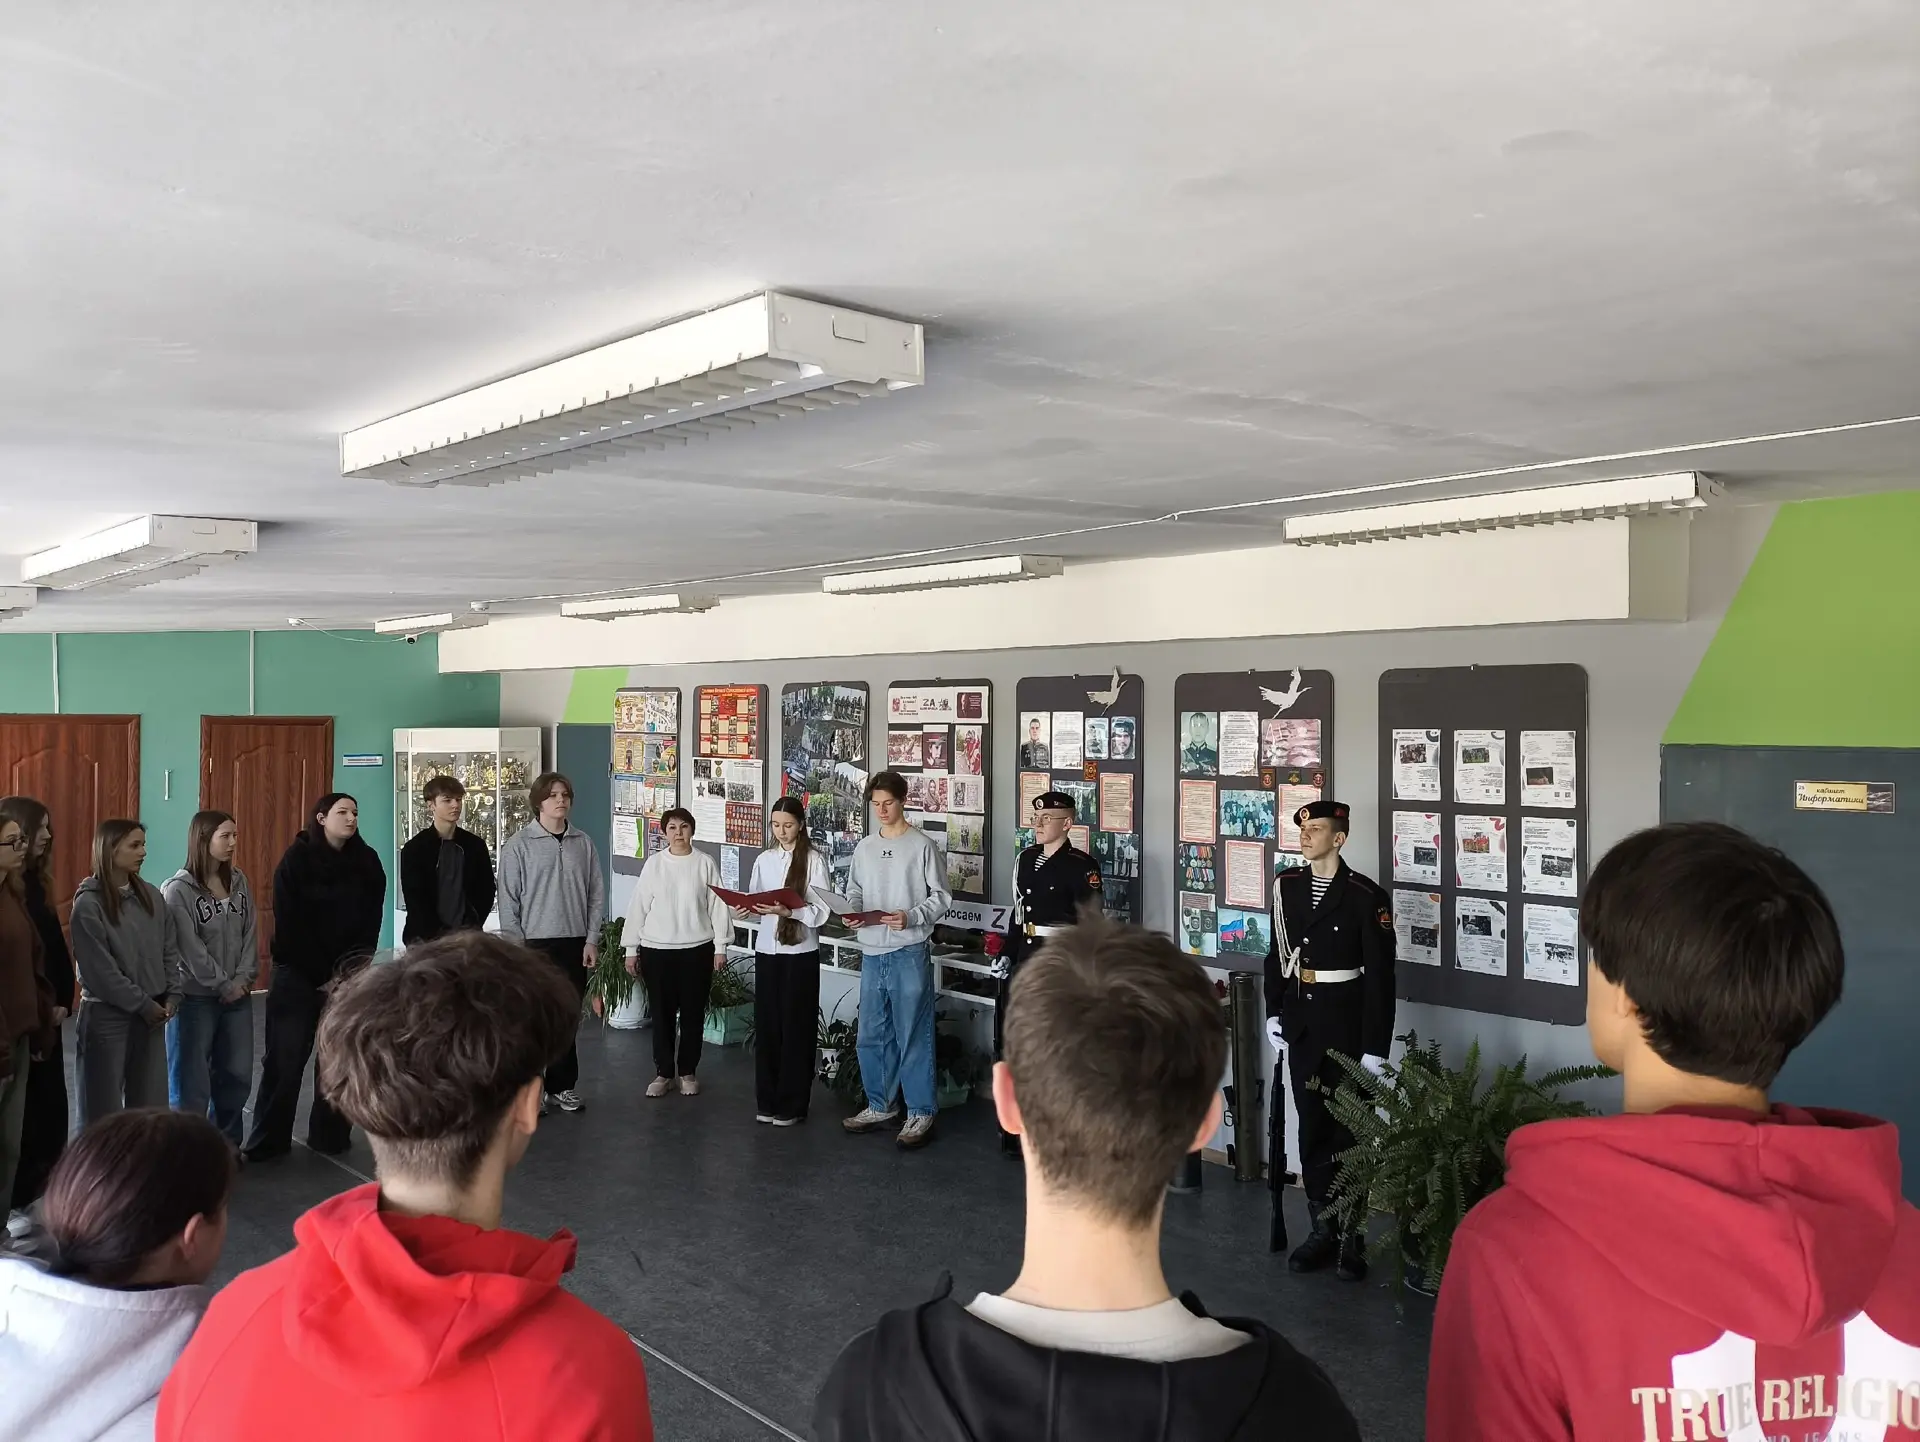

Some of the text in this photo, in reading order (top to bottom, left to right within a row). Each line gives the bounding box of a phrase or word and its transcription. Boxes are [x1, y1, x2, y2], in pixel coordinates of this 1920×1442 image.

[1798, 793, 1864, 805] Информатики
[990, 908, 1007, 930] Z
[1631, 1382, 1754, 1442] TRUE
